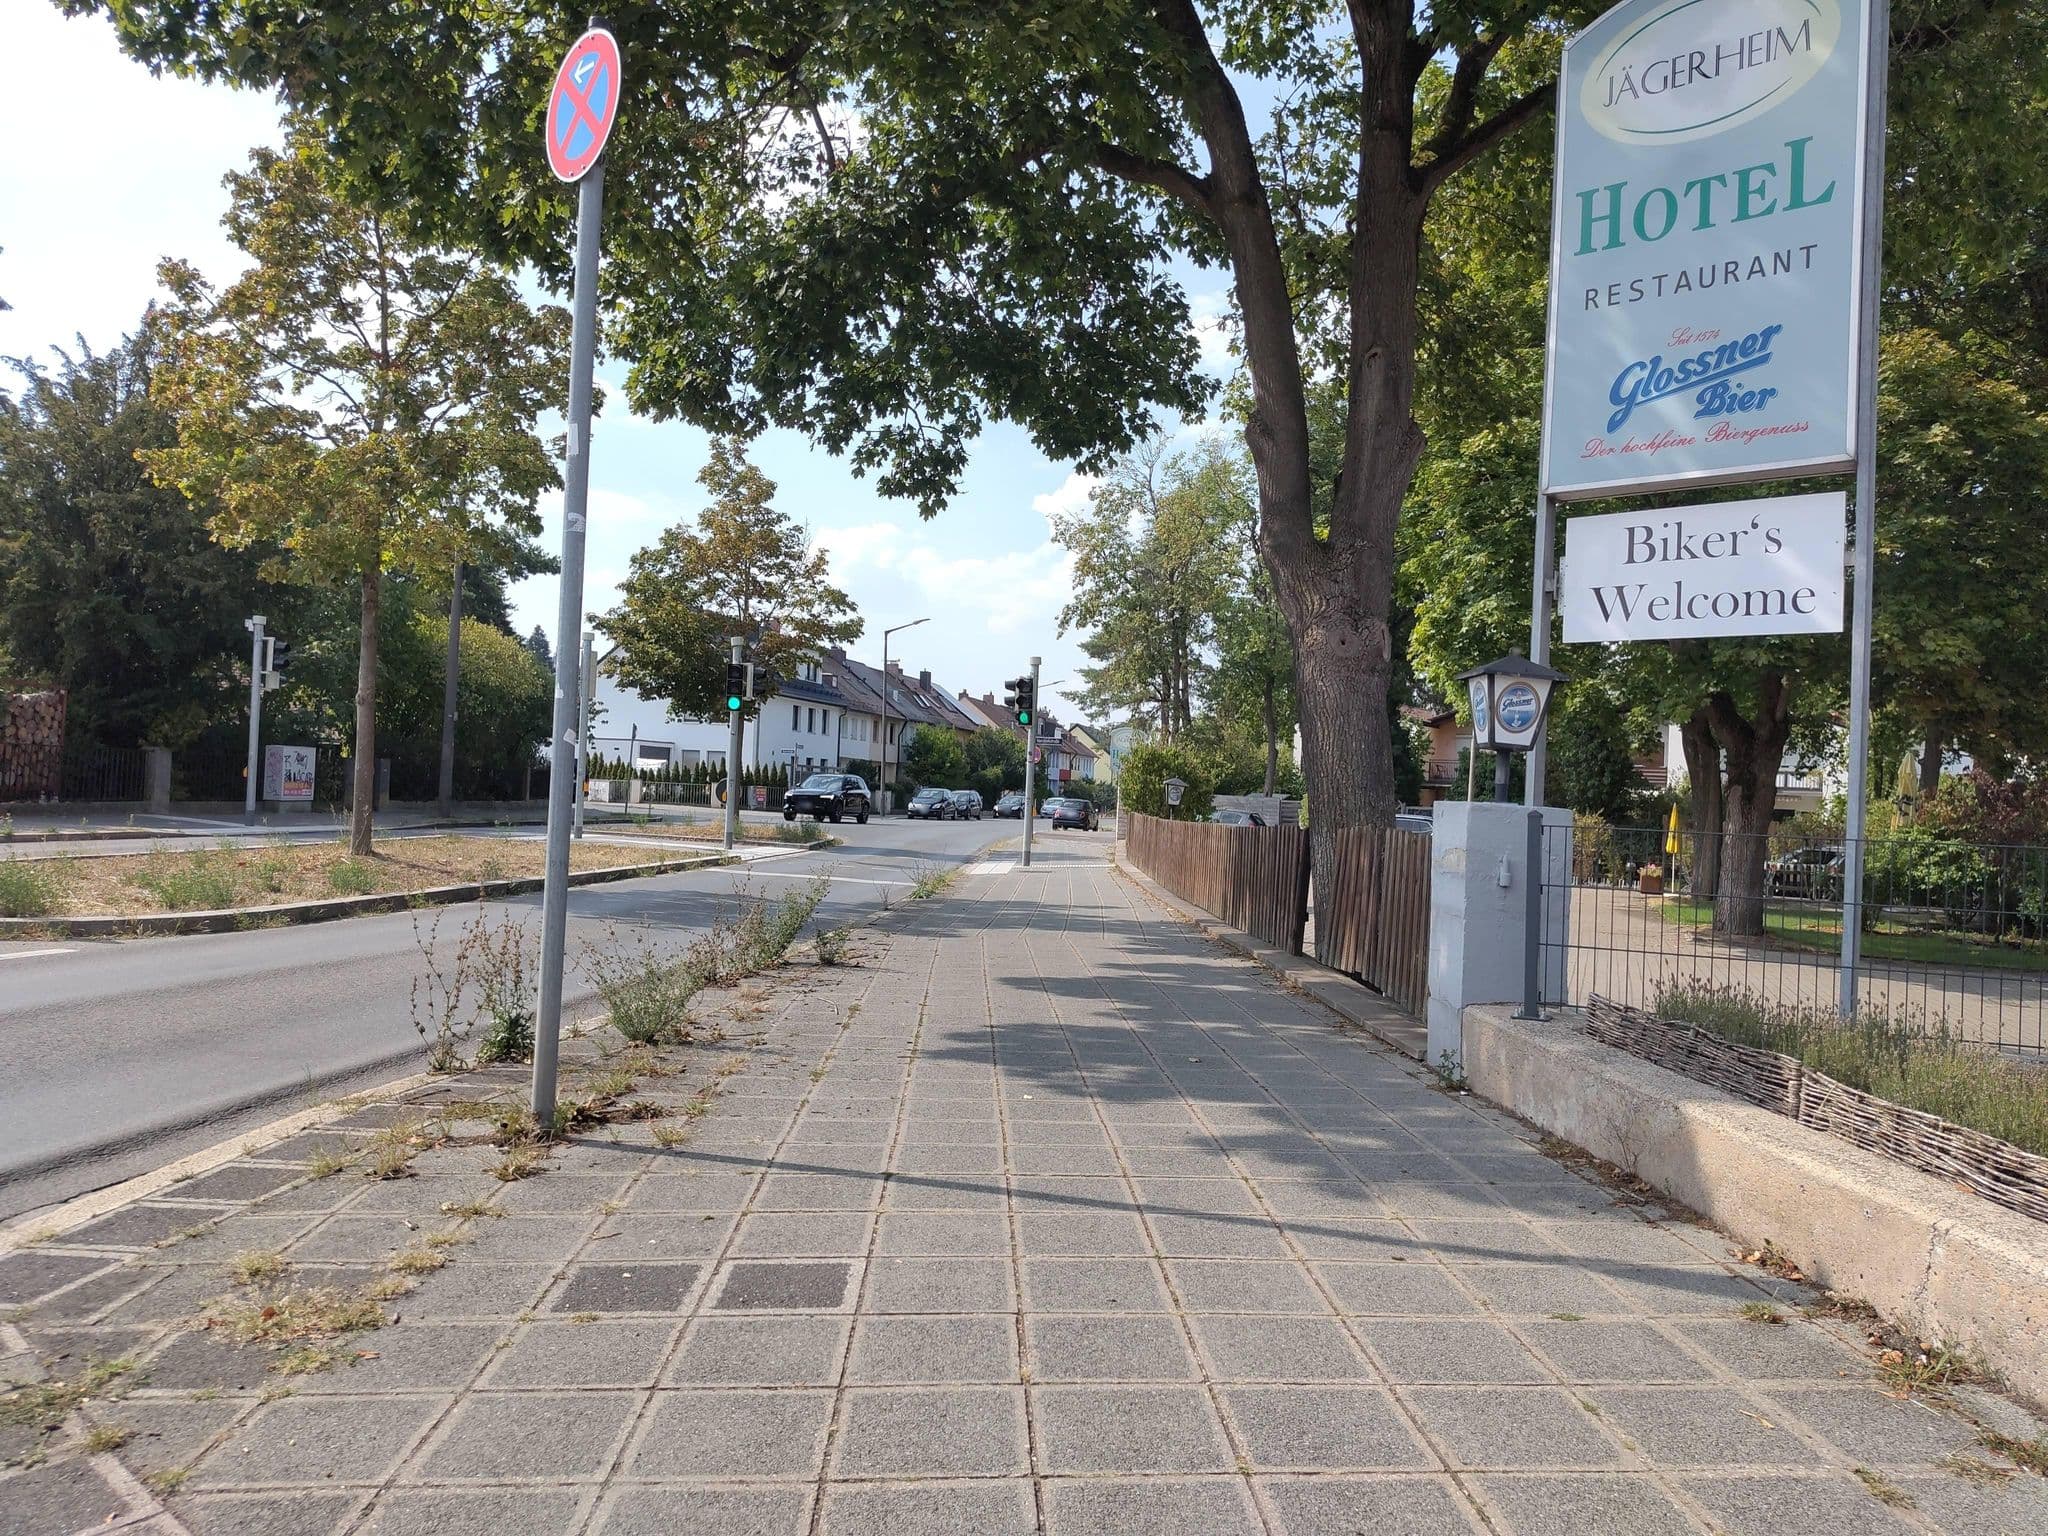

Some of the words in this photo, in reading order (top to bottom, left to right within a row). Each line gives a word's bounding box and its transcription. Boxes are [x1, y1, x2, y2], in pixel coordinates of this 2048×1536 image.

[1602, 18, 1811, 108] JÄGERHEIM
[1573, 136, 1837, 257] HOTEL
[1584, 244, 1819, 310] RESTAURANT
[1606, 323, 1783, 434] Glossner
[1693, 378, 1778, 419] Bier
[1580, 438, 1617, 458] Der
[1620, 429, 1696, 456] hochfeine
[1704, 421, 1810, 445] Biergenuss
[1590, 580, 1817, 624] Welcome
